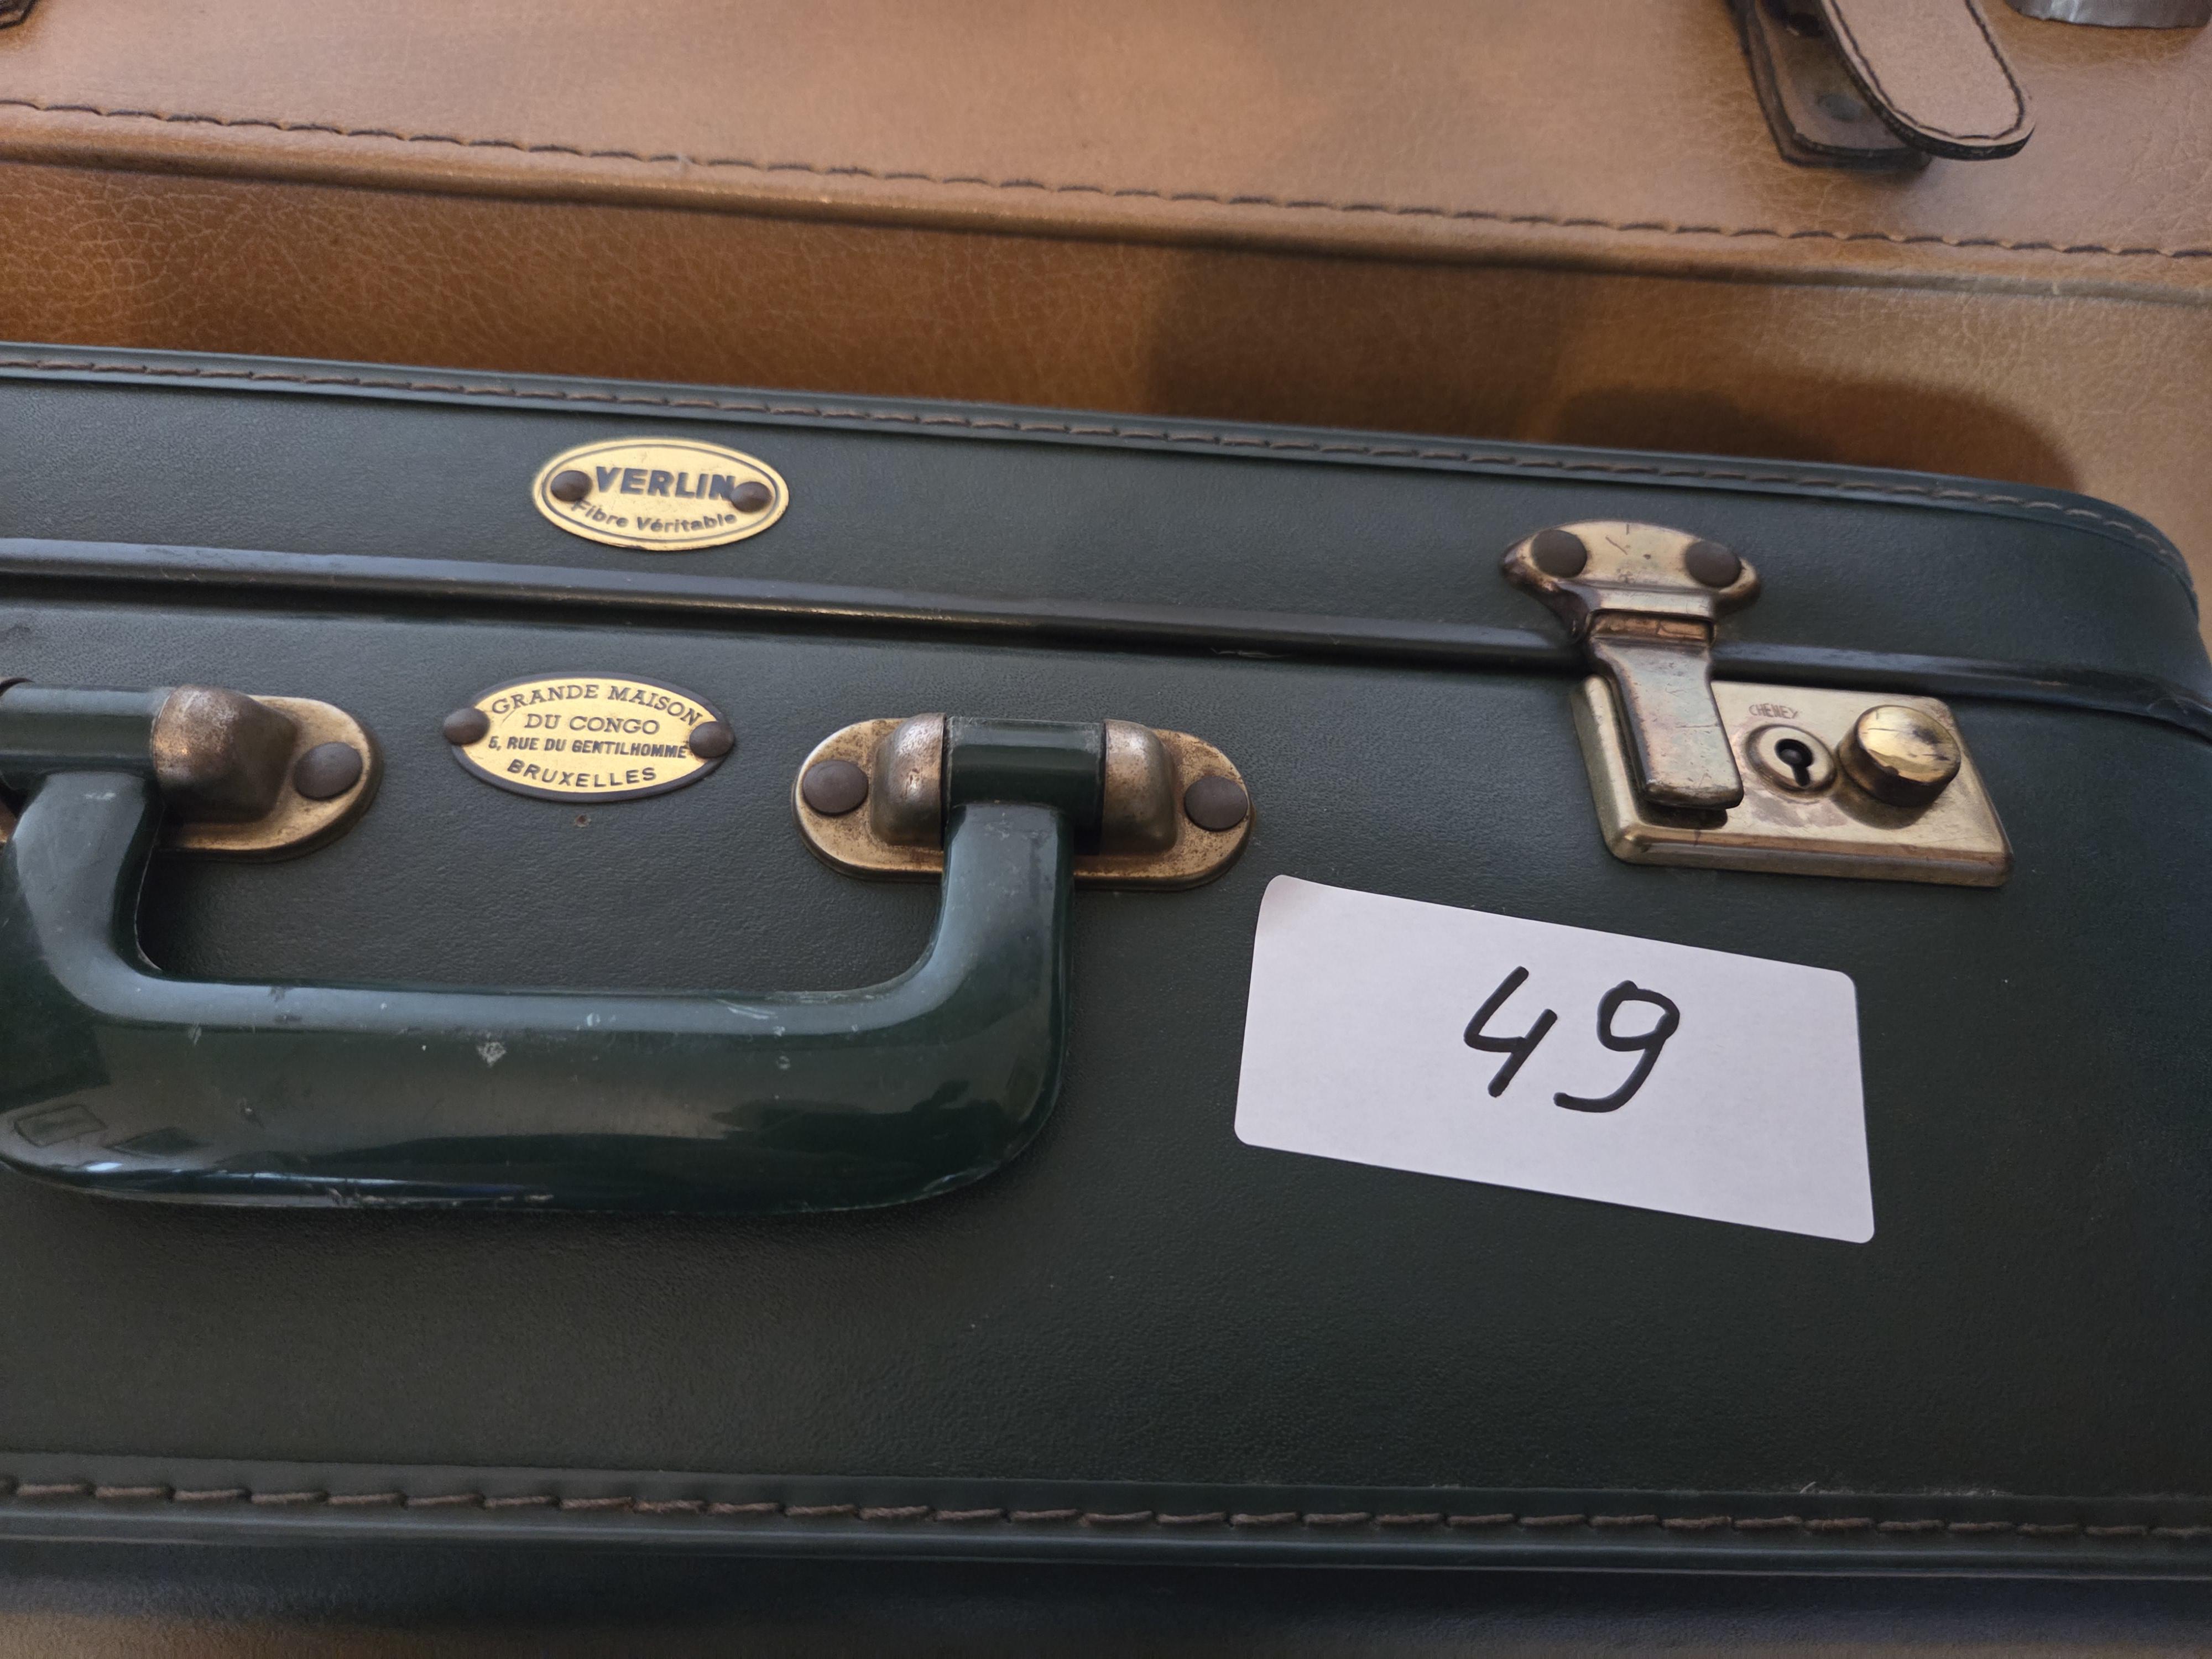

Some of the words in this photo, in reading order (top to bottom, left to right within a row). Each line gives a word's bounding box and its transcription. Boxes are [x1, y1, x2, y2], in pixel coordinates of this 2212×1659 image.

[596, 466, 736, 500] VERLIN
[571, 498, 629, 528] Fibre
[637, 514, 737, 533] Véritable
[492, 684, 599, 714] GRANDE
[608, 685, 703, 726] MAISON
[1749, 703, 1798, 719] CHENEY
[524, 713, 562, 729] DU
[570, 716, 660, 735] CONGO
[507, 736, 540, 750] RUE
[544, 738, 567, 752] DU
[572, 739, 687, 758] GENTILHOMME
[507, 759, 656, 787] BRUXELLES
[1463, 966, 1680, 1113] 49
